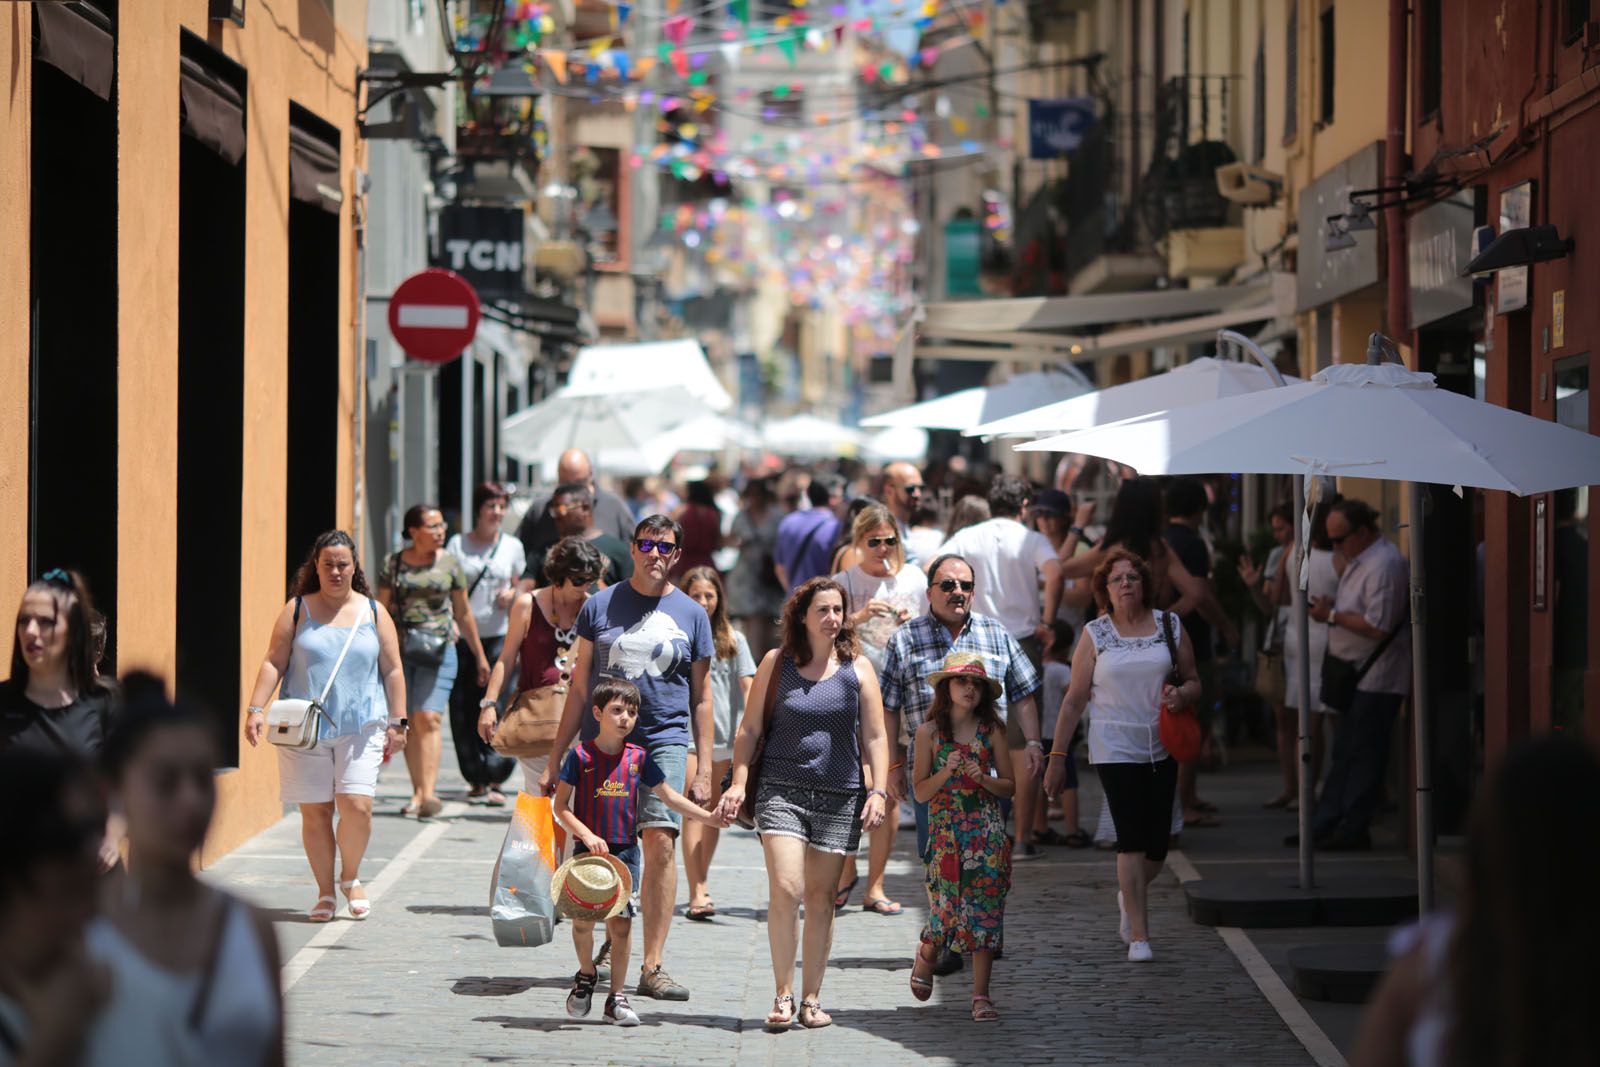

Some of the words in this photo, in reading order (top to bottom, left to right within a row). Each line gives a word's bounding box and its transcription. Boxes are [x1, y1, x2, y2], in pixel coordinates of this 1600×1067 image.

[446, 239, 521, 272] TCN
[603, 779, 624, 791] Qatar
[594, 788, 629, 798] Foundation
